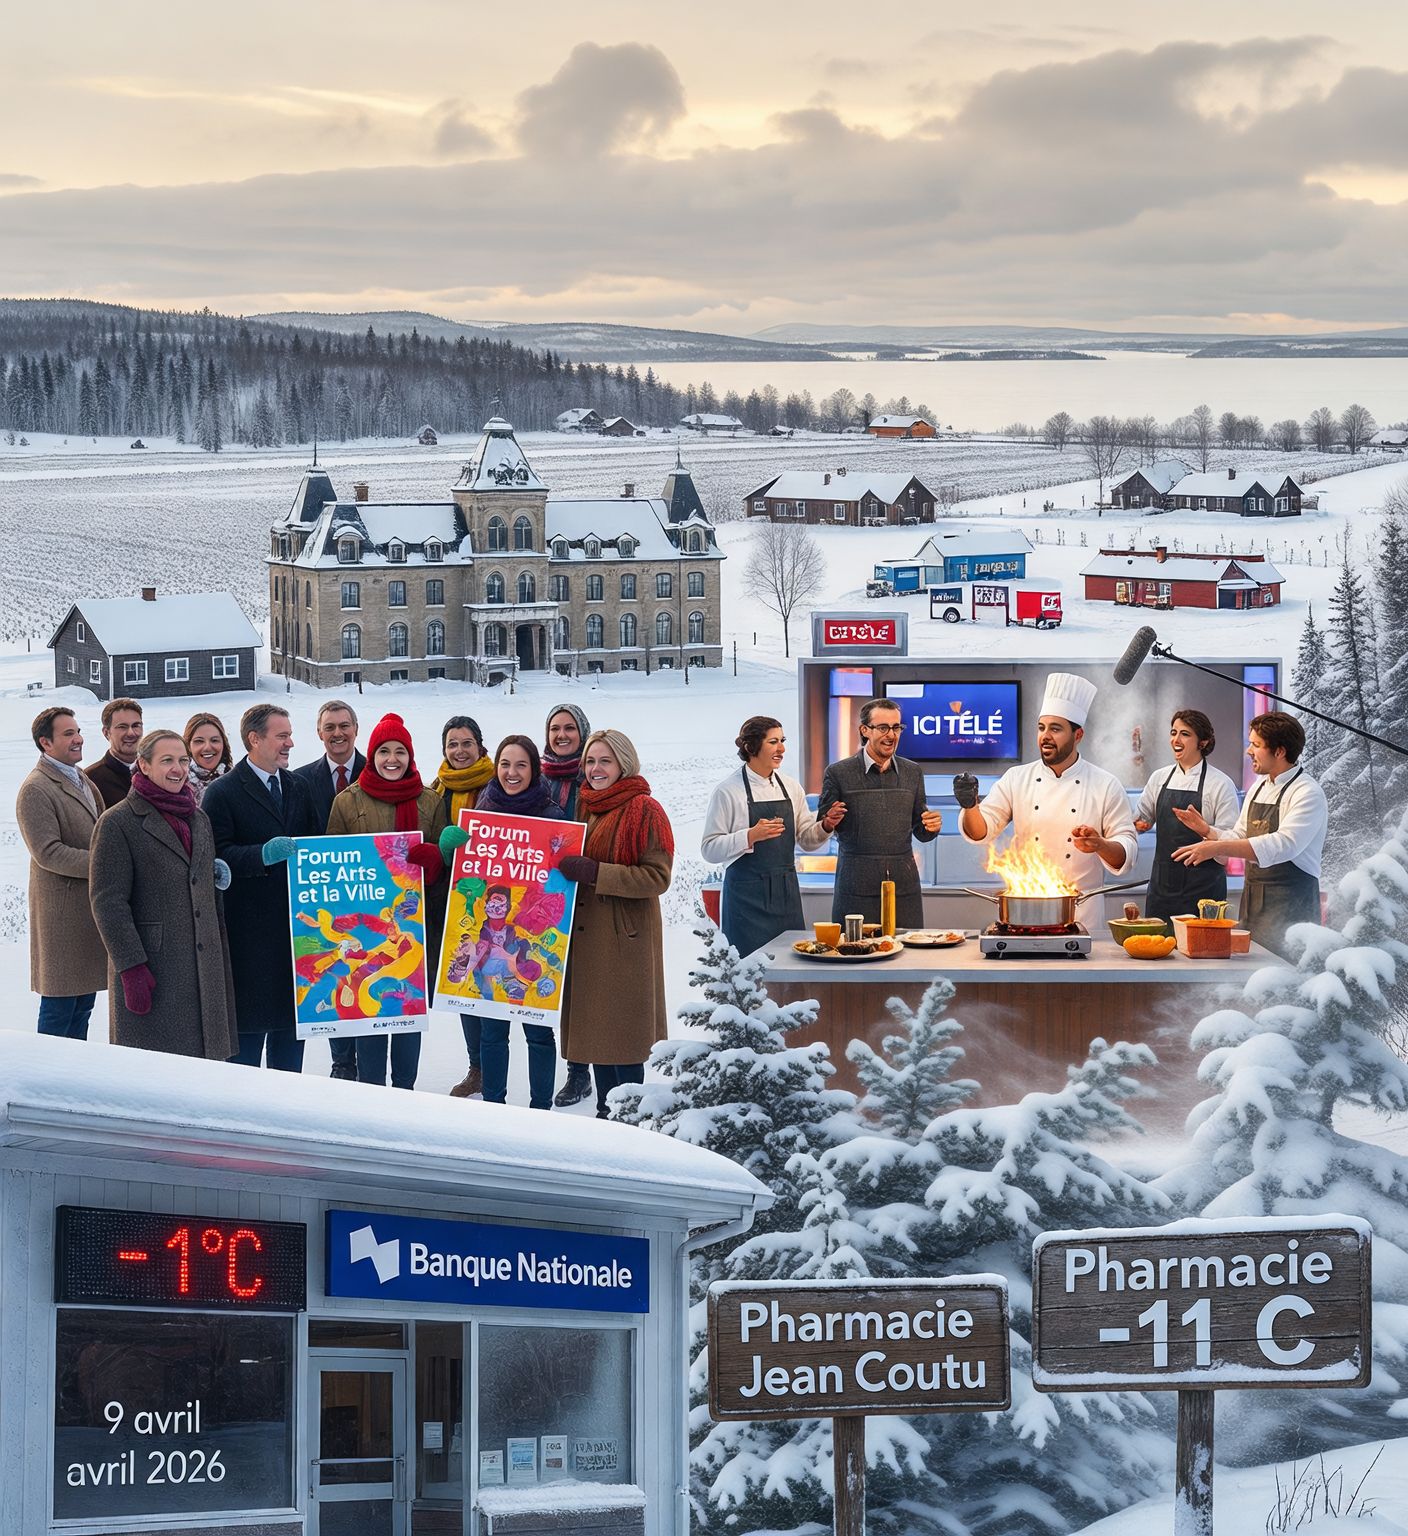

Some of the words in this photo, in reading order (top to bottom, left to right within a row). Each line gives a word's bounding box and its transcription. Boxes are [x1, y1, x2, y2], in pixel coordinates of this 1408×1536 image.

[913, 715, 941, 735] ICI
[944, 709, 1003, 735] TÉLÉ
[468, 819, 530, 843] Forum
[297, 848, 362, 867] Forum
[465, 838, 498, 858] Les
[297, 867, 329, 885] Les
[335, 866, 377, 884] Arts
[462, 858, 481, 875] et
[487, 860, 503, 878] la
[509, 861, 549, 884] Ville
[298, 888, 318, 904] et
[321, 886, 340, 903] la
[343, 884, 386, 902] Ville
[410, 1242, 512, 1288] Banque
[517, 1252, 633, 1289] Nationale
[1064, 1239, 1333, 1294] Pharmacie
[740, 1298, 974, 1344] Pharmacie
[1099, 1298, 1211, 1368] -11
[1256, 1294, 1316, 1367] C
[739, 1353, 844, 1399] Jean
[855, 1352, 986, 1394] Coutu
[103, 1401, 124, 1436] 9
[133, 1400, 201, 1436] avril
[66, 1451, 135, 1487] avril
[147, 1450, 226, 1485] 2026
